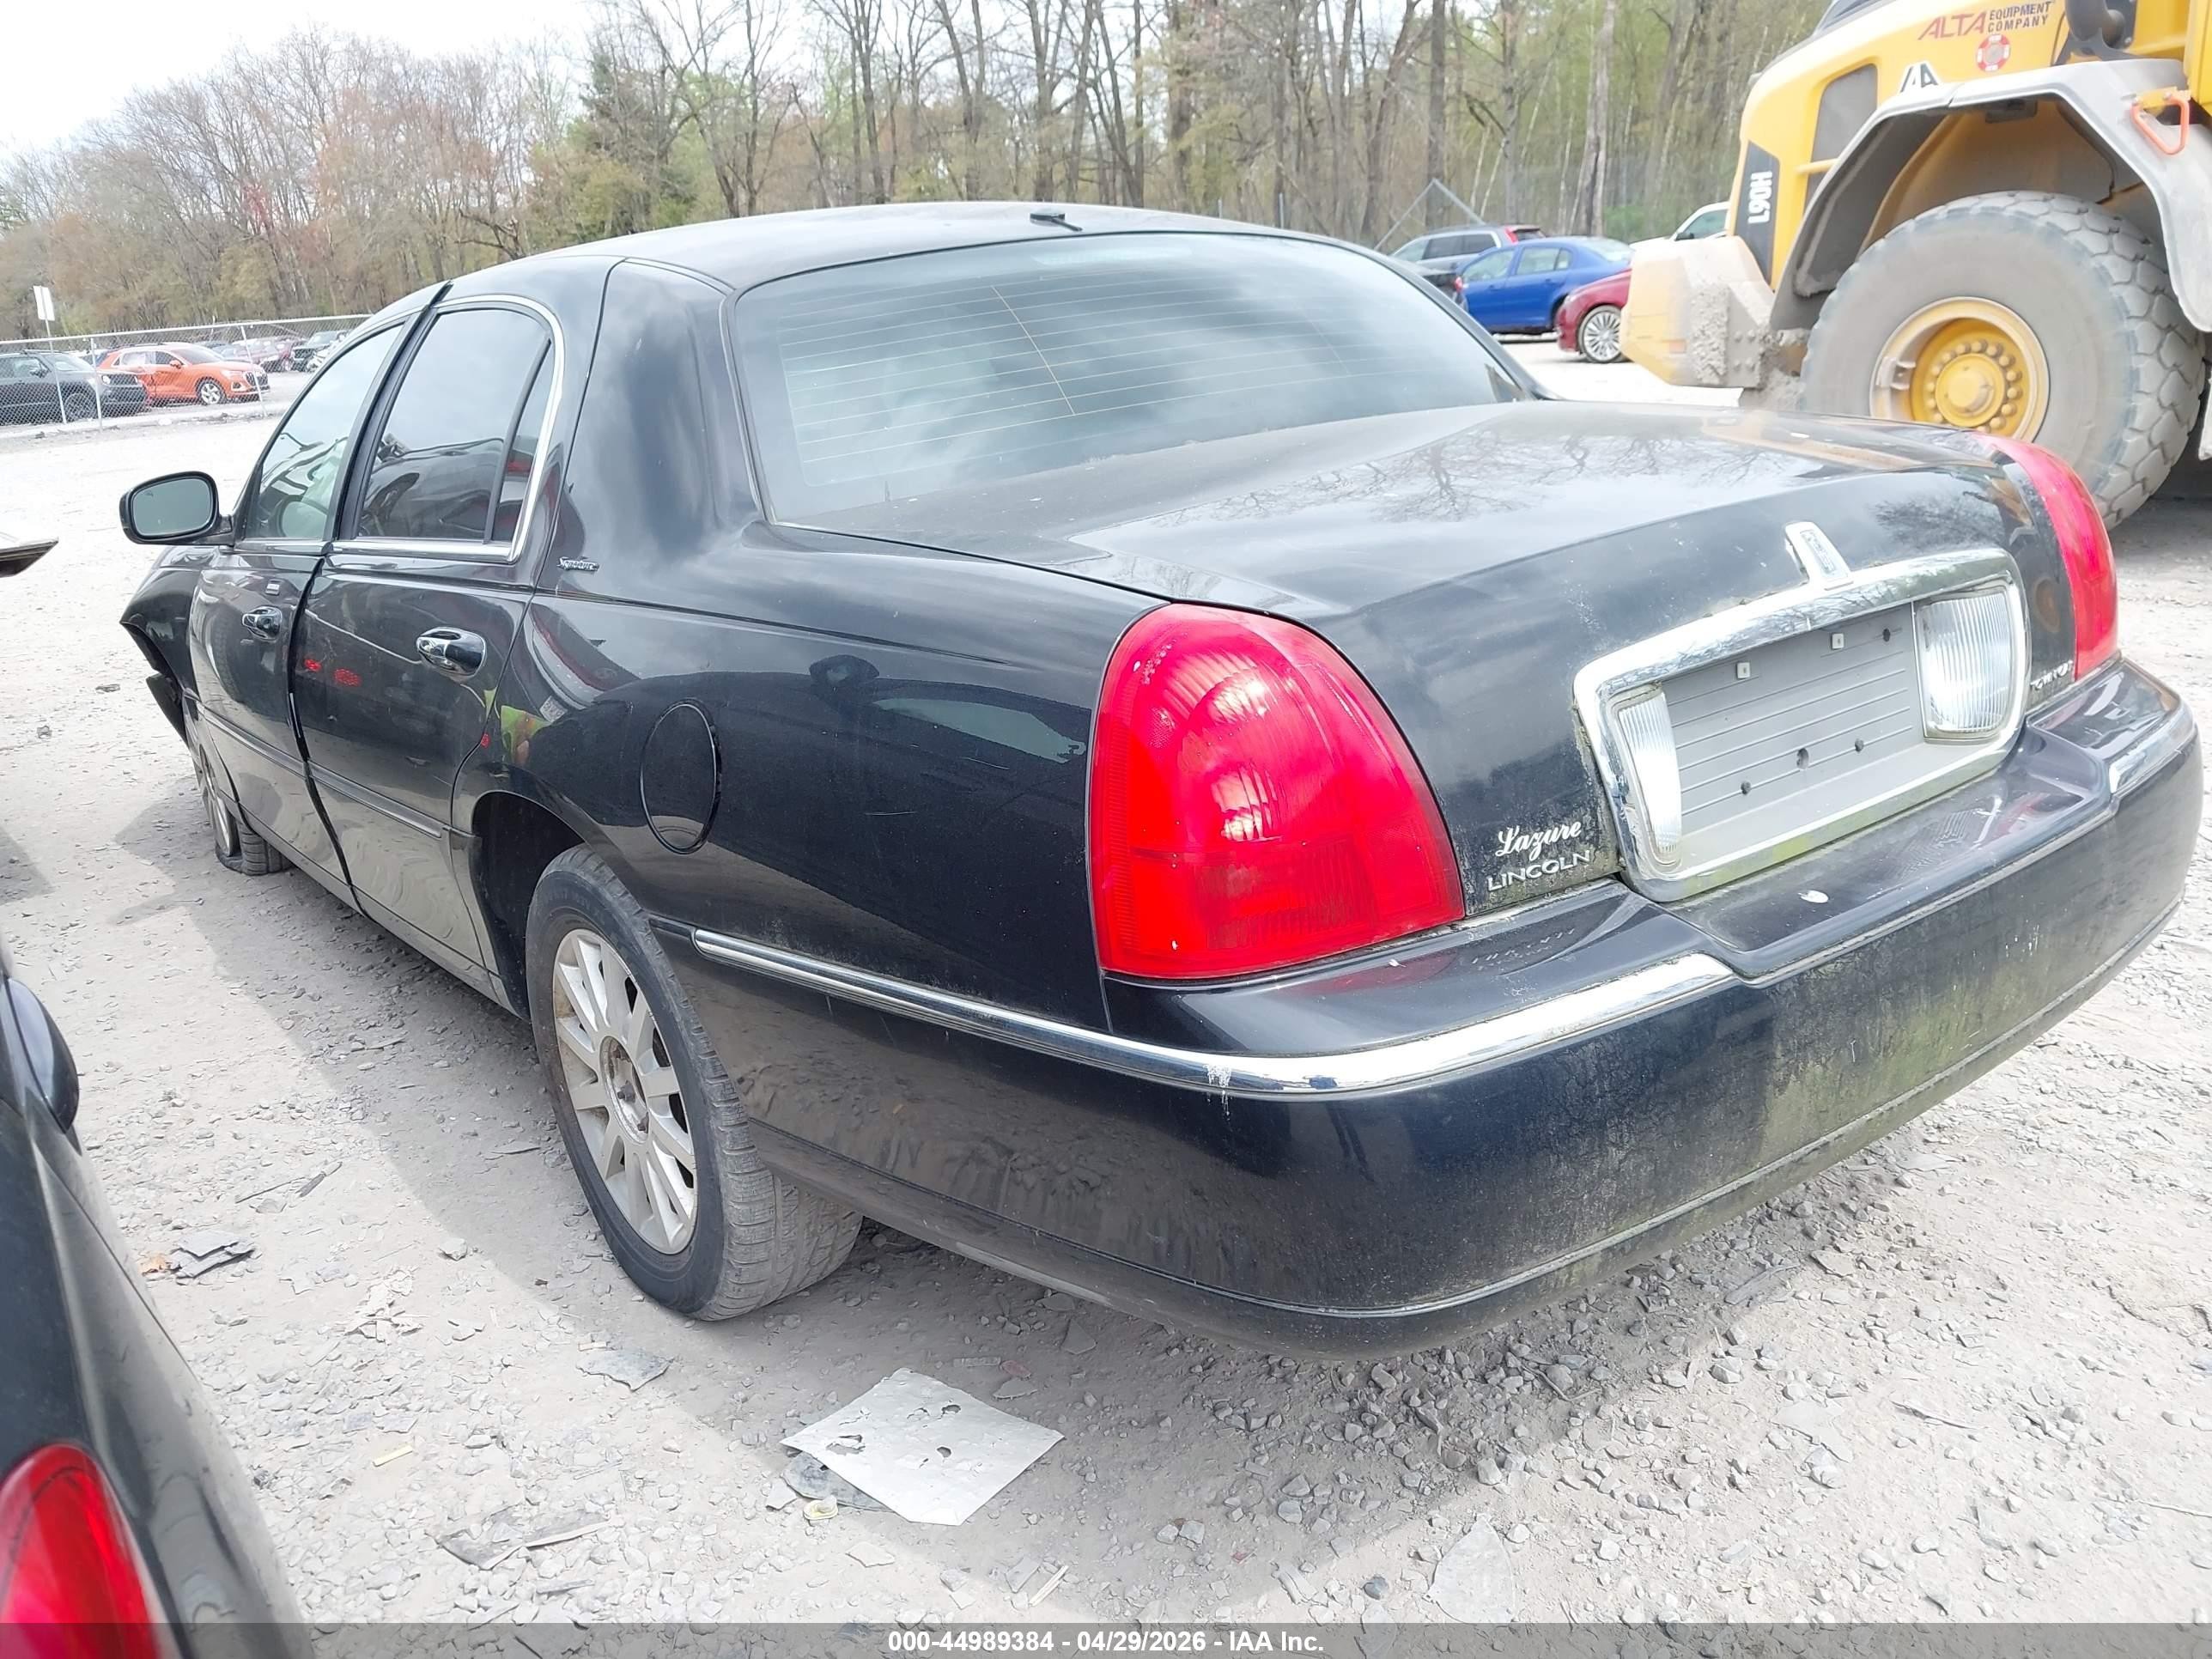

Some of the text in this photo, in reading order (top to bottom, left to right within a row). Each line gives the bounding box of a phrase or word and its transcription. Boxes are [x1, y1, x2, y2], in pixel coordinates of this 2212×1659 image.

[1917, 10, 1987, 40] ALTA
[1988, 15, 2048, 33] COMPANY
[1989, 2, 2052, 21] EQUIPMENT
[1747, 171, 1773, 223] L90H
[1495, 821, 1582, 861] Lazure
[1487, 850, 1590, 891] LINCOLN
